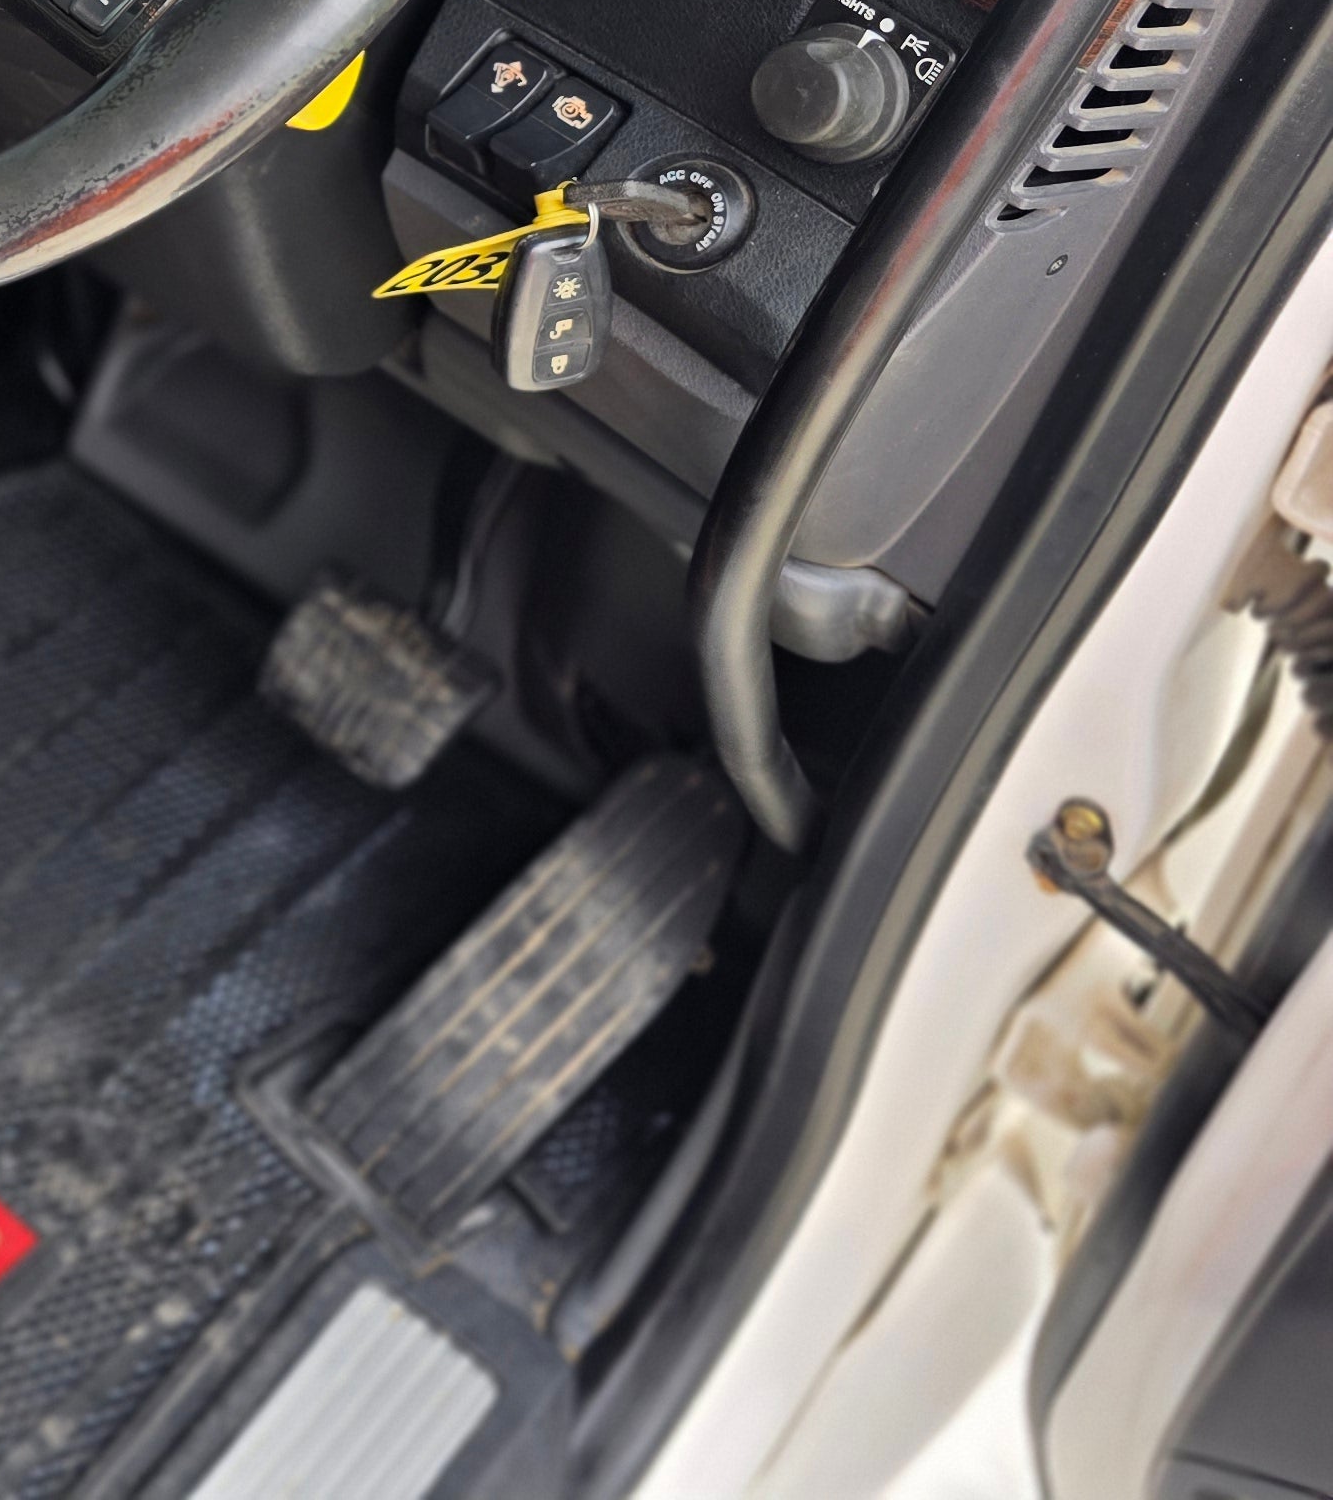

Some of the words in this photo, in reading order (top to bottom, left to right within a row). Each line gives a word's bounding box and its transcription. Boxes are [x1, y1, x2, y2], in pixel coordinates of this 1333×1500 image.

[659, 169, 686, 185] ACC
[689, 171, 714, 189] OFF
[710, 192, 725, 213] ON
[695, 215, 724, 252] START
[381, 251, 511, 293] 203
